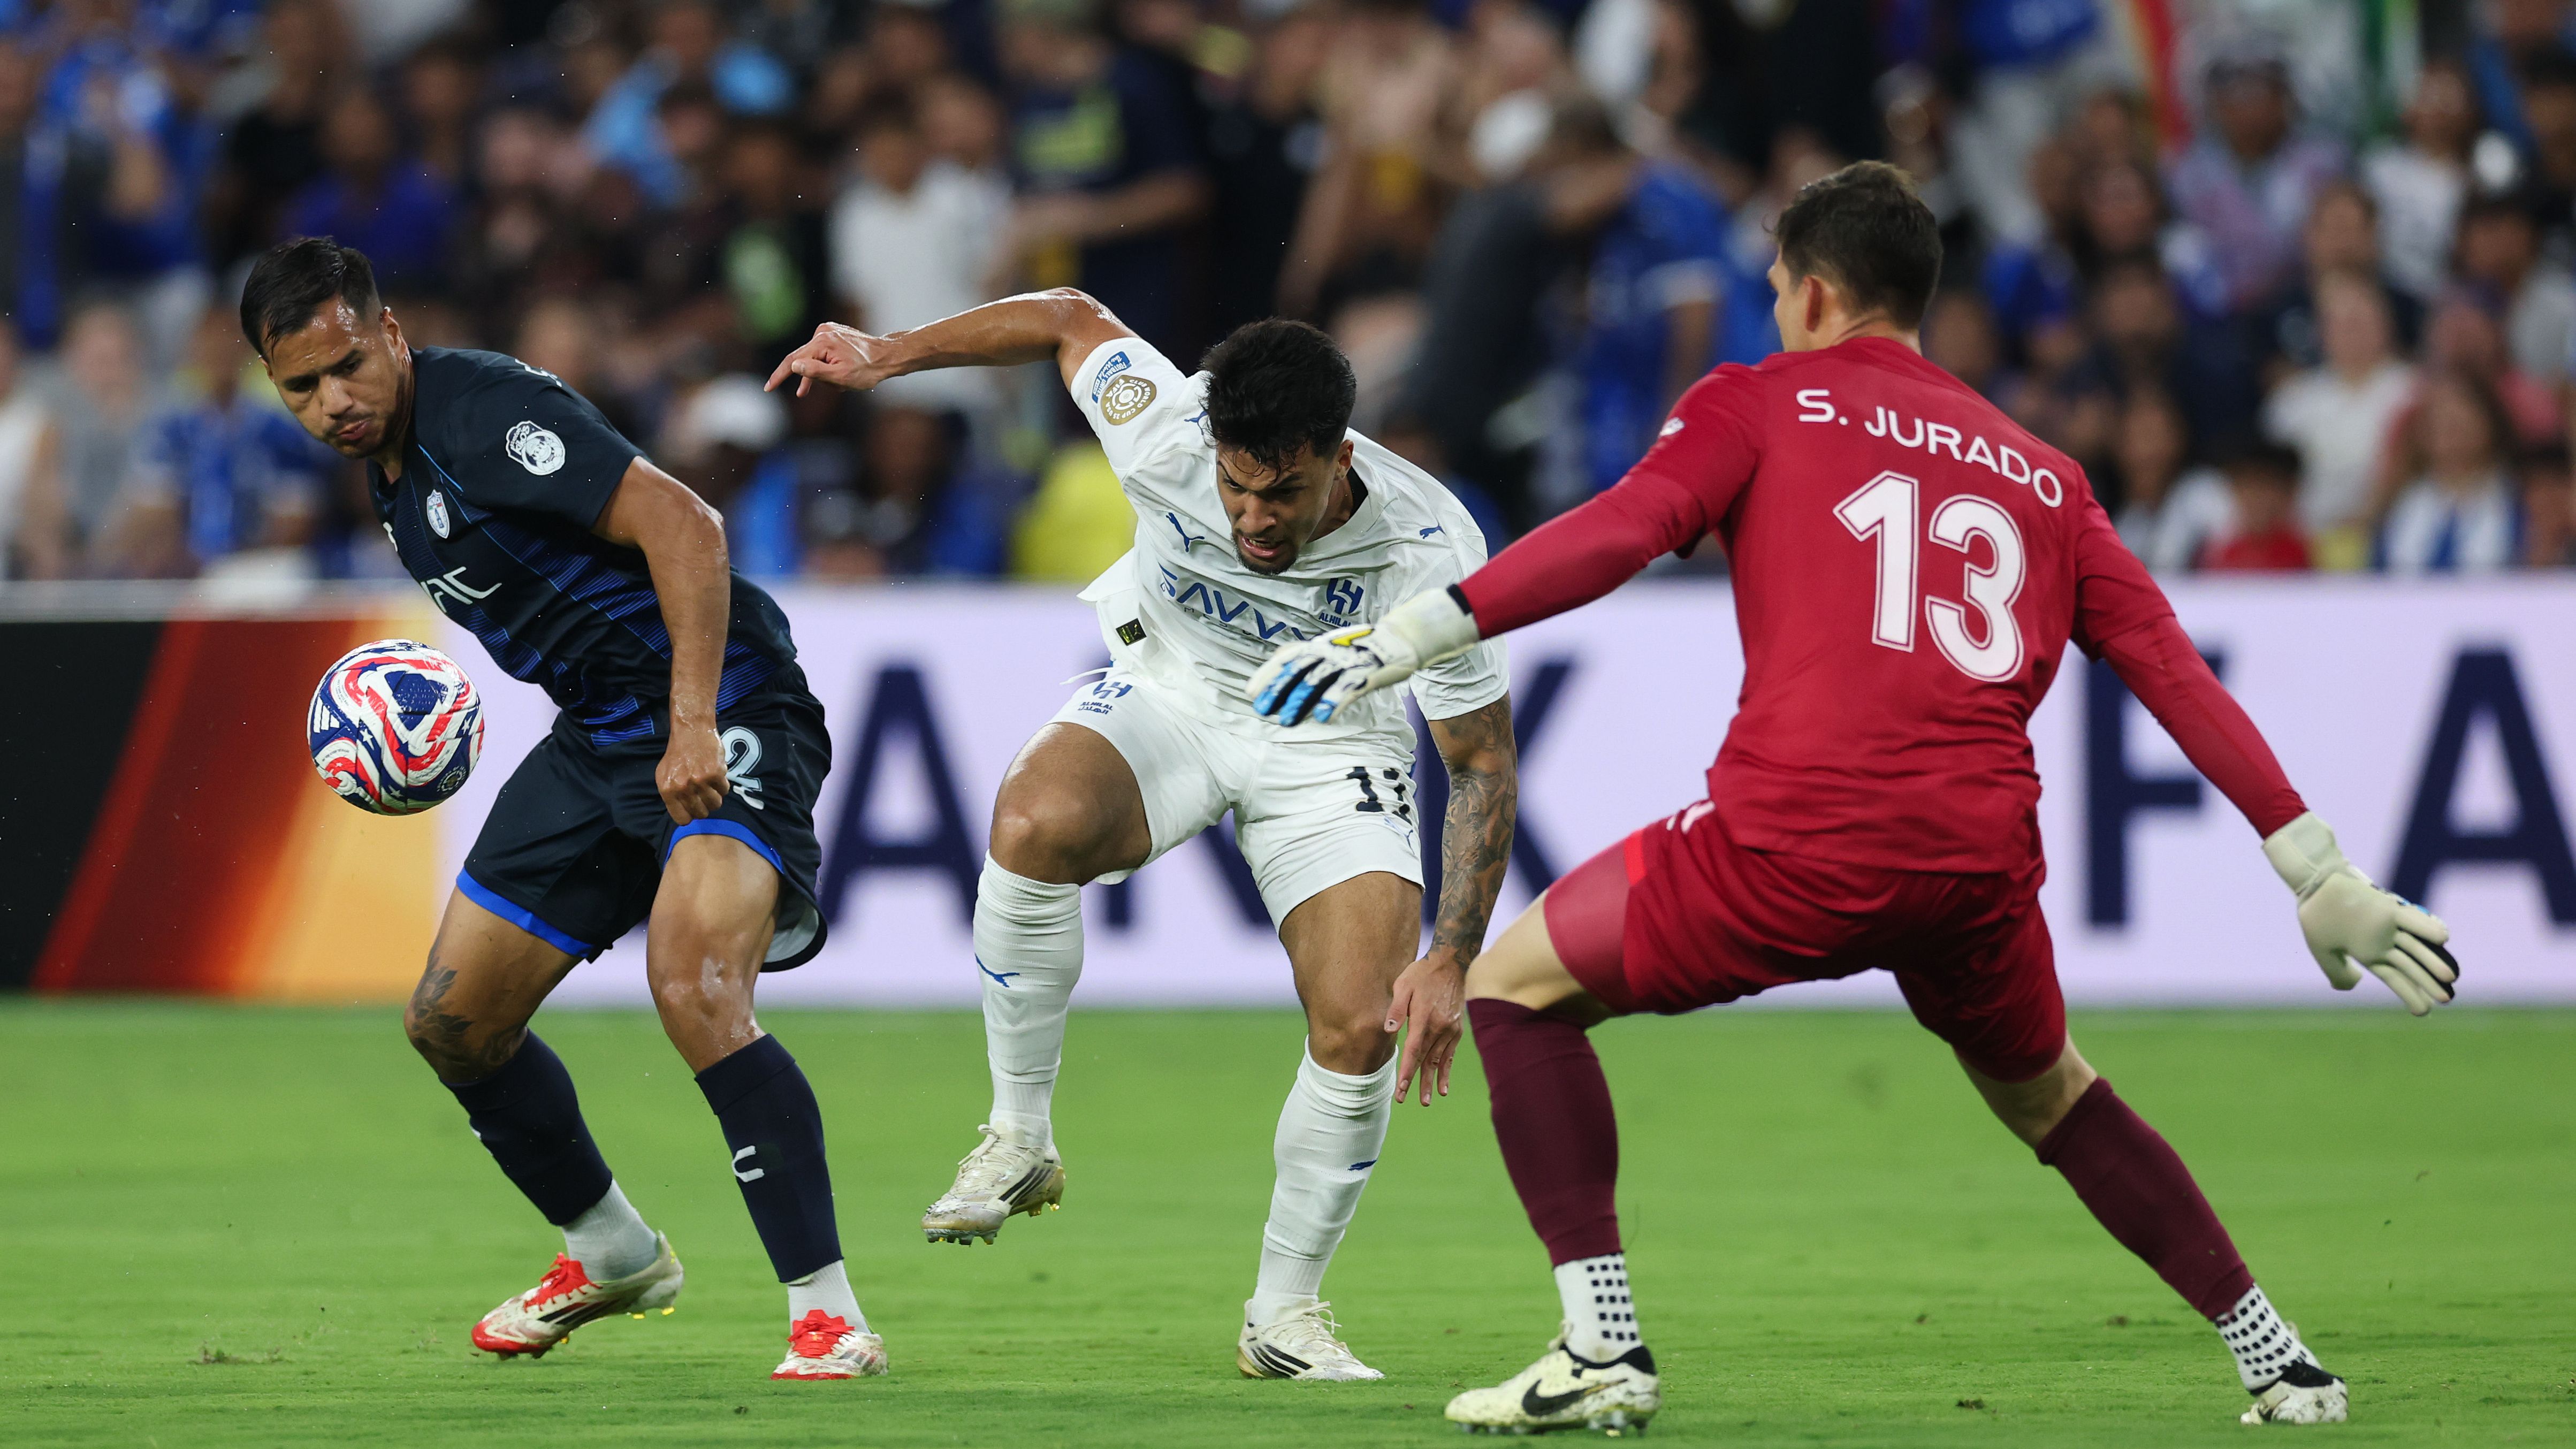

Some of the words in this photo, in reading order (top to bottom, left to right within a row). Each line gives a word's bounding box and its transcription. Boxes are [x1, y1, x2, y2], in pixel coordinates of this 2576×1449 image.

[1104, 362, 1127, 378] FOOTBALL
[1106, 378, 1125, 397] FIFA
[1129, 379, 1148, 387] CLUB
[1137, 386, 1151, 408] WORLD
[1122, 408, 1136, 418] CUP
[1796, 390, 1848, 425] S.
[1864, 406, 2063, 508] JURADO
[1833, 470, 2026, 682] 13
